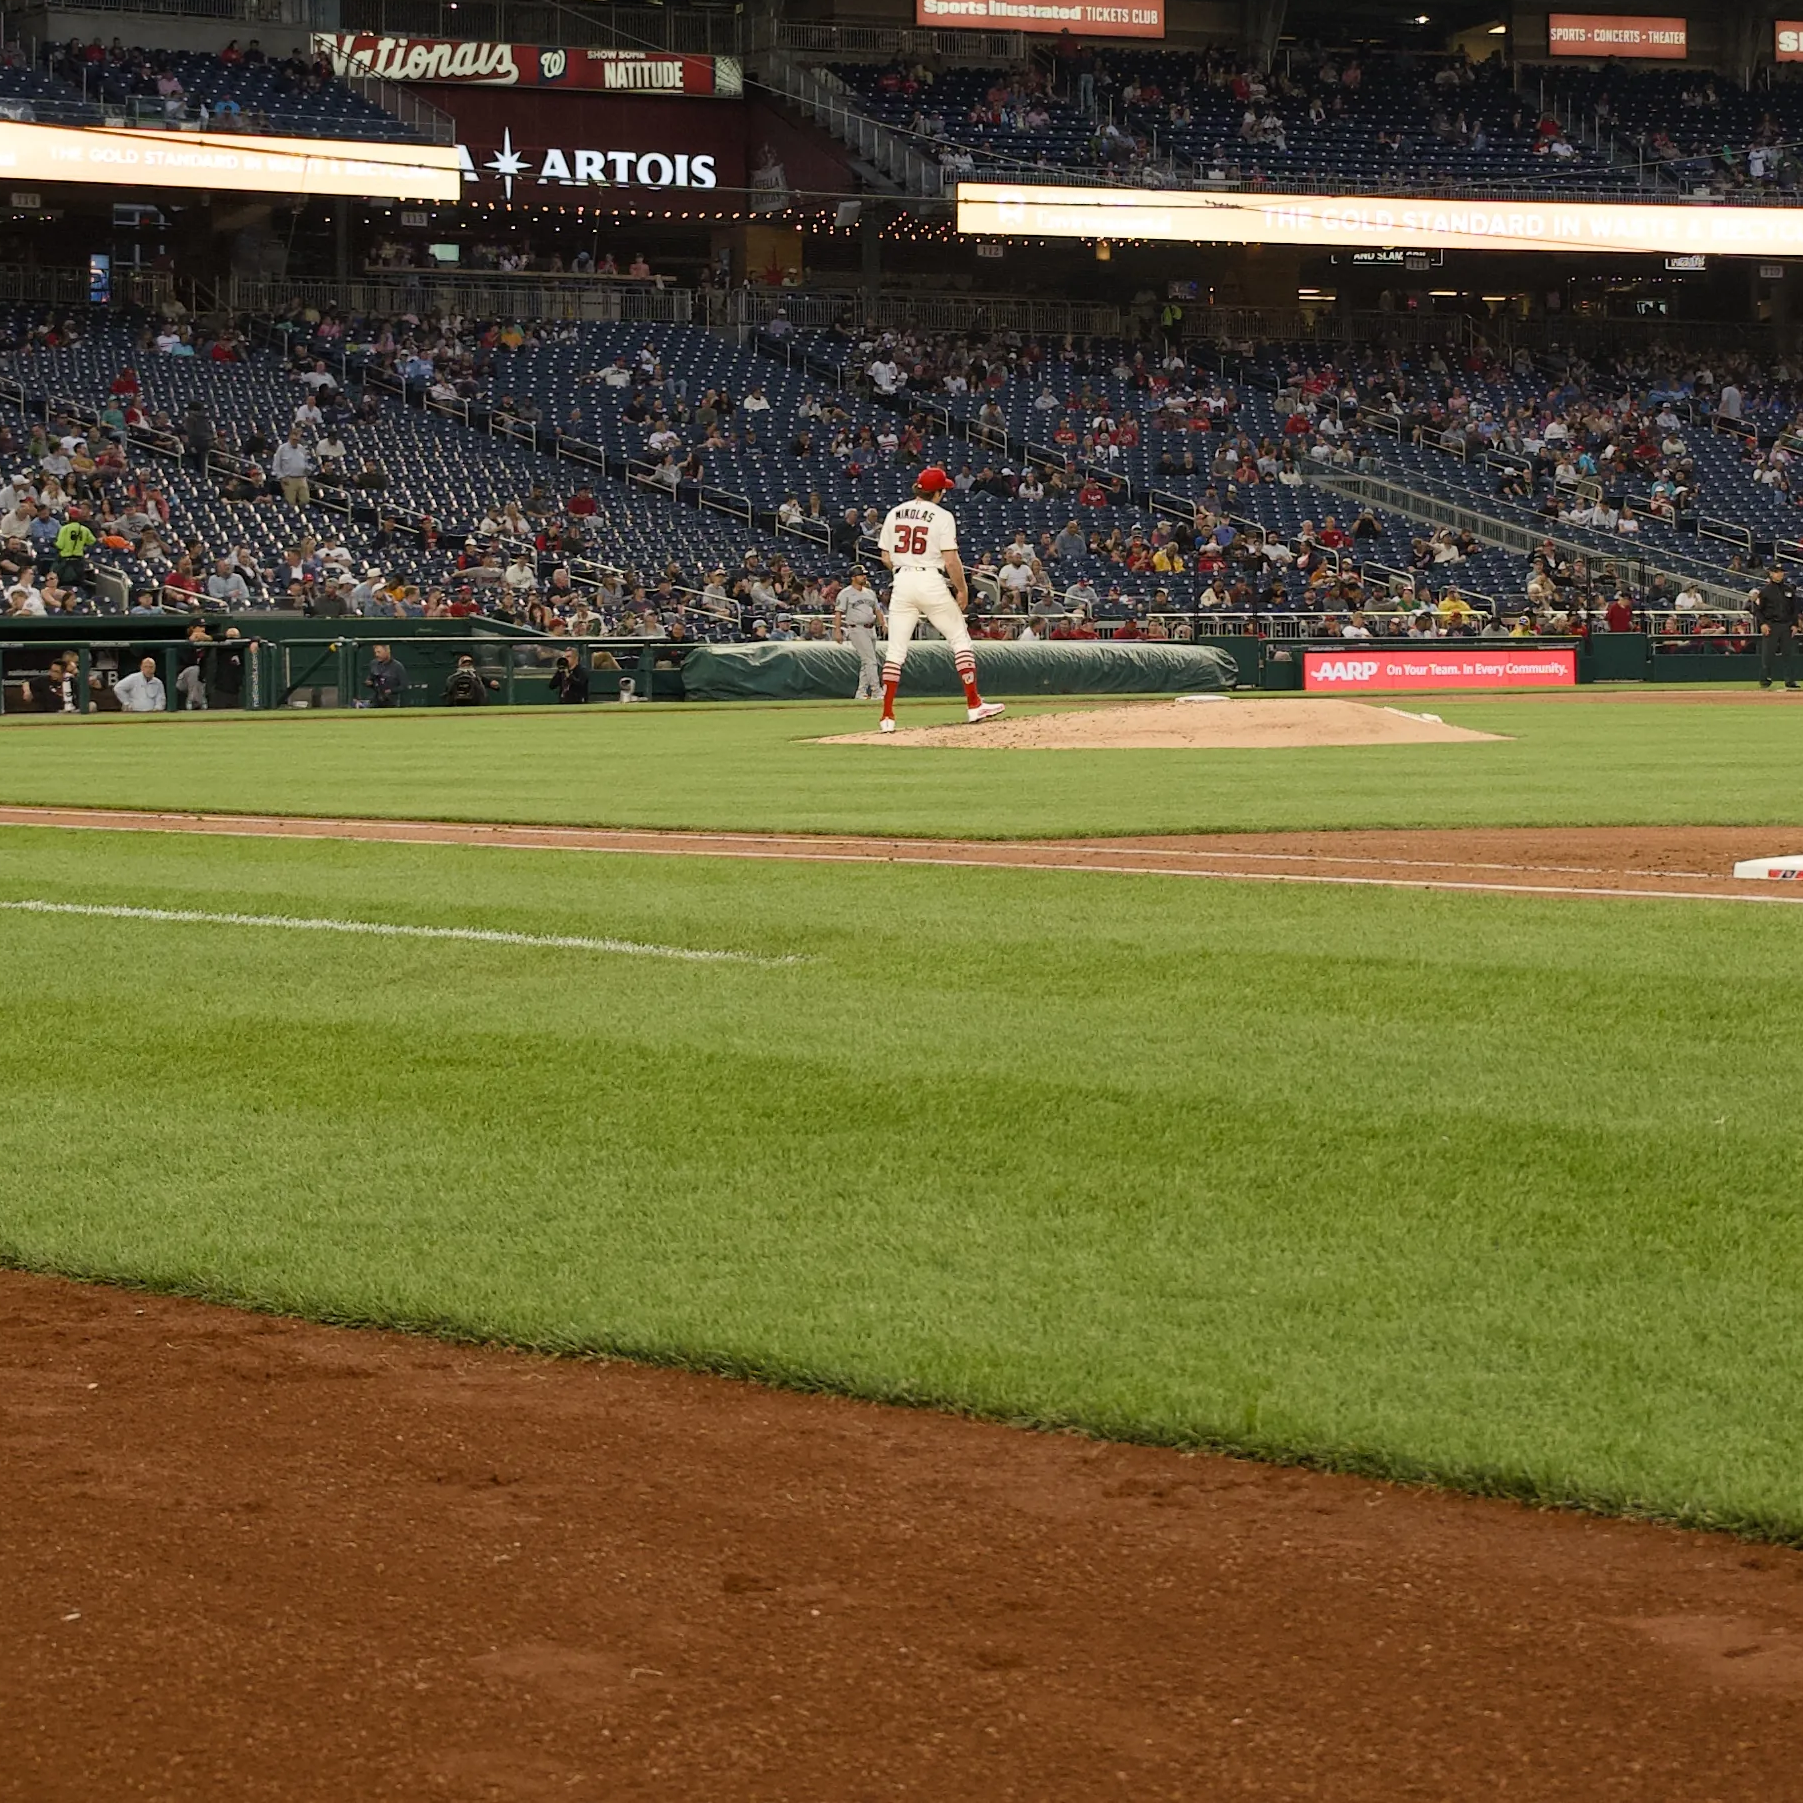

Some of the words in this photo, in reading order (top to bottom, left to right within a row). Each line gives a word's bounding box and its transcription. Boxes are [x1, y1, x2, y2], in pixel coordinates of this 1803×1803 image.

[988, 0, 1083, 21] Illustrated
[1085, 5, 1129, 24] TICKETS
[1132, 8, 1158, 25] CLUB
[1550, 28, 1586, 41] SPORTS
[1593, 29, 1640, 43] CONCERTS
[1648, 30, 1686, 45] THEATER
[587, 51, 617, 60] SHOW
[604, 61, 684, 89] NATITUDE
[537, 148, 717, 191] ARTOIS
[1261, 206, 1313, 230] THE
[1322, 209, 1394, 232] GOLD
[1402, 211, 1543, 236] STANDARD
[1553, 215, 1580, 238] IN
[895, 509, 935, 523] MIKOLAS
[894, 525, 928, 554] 36
[1311, 662, 1379, 682] AARP
[1387, 664, 1403, 679] On
[1404, 664, 1428, 679] Your
[1429, 663, 1460, 679] Team.
[1462, 663, 1472, 678] In
[1473, 663, 1504, 680] Every
[1505, 662, 1568, 679] Community.
